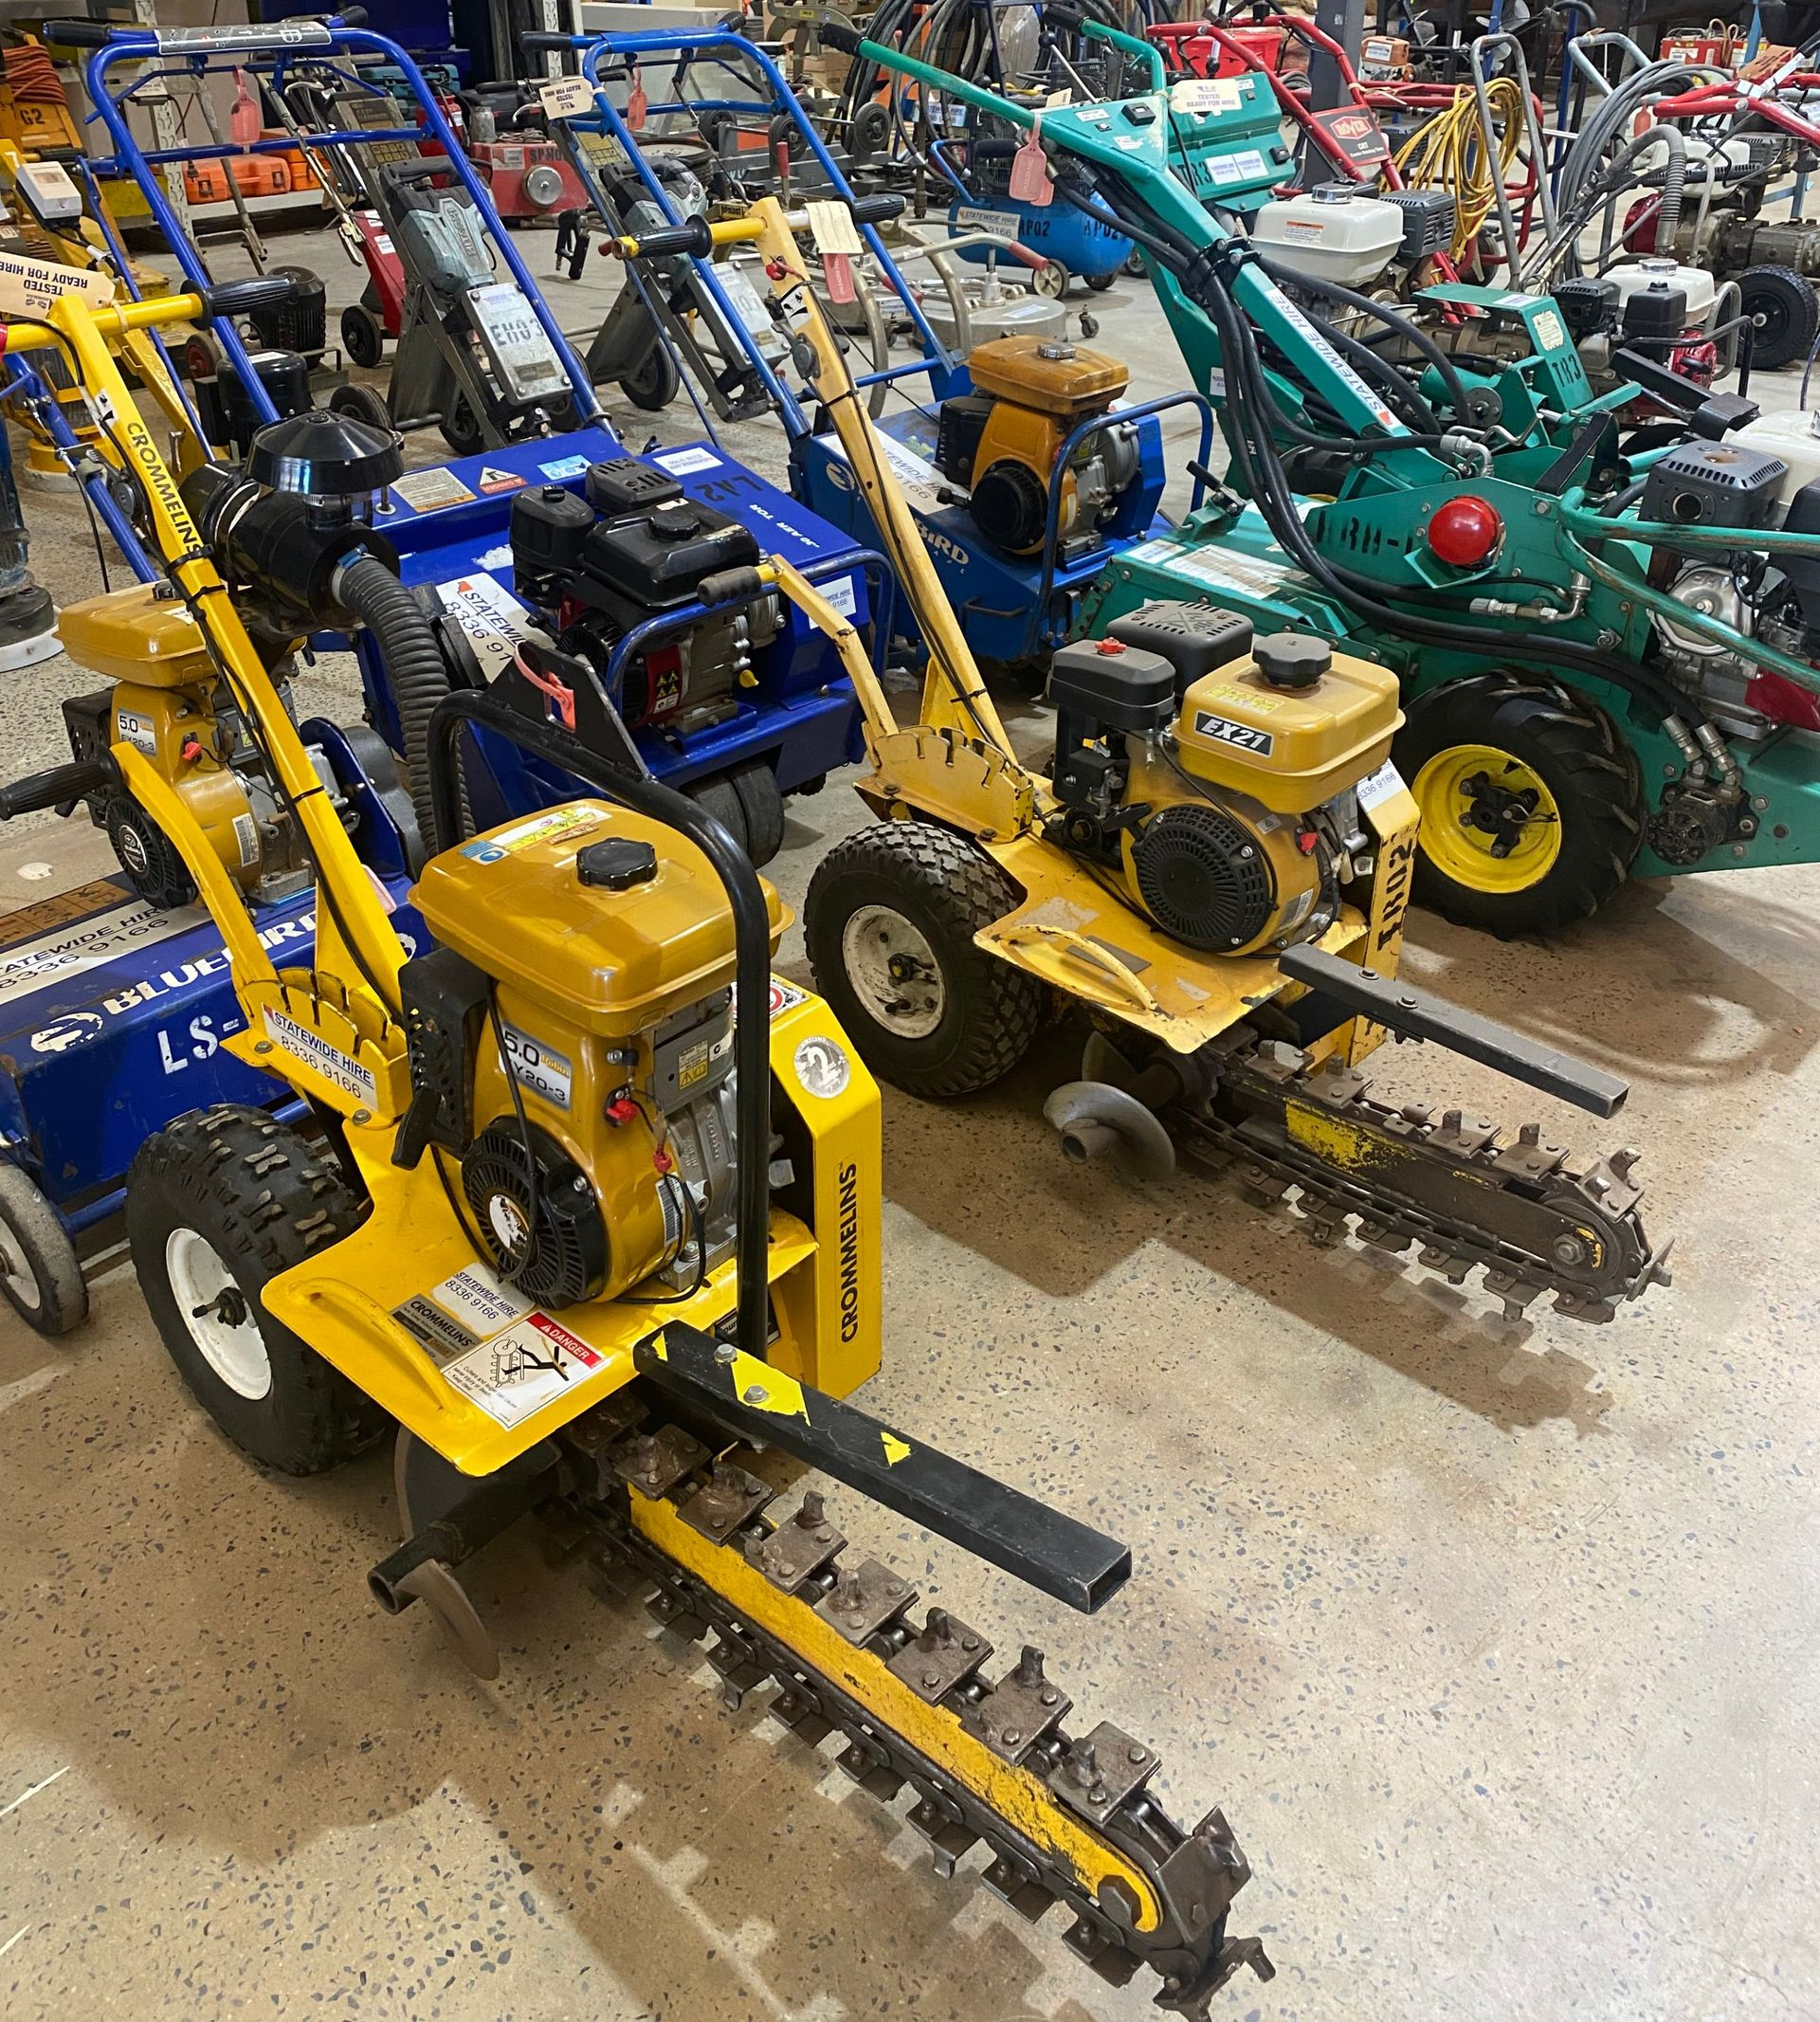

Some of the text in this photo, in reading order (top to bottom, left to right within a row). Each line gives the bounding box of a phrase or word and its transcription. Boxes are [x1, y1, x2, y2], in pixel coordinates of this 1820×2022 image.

[19, 108, 46, 126] G2
[963, 209, 1018, 226] STATEWIDE HIRE
[23, 279, 64, 296] TESTED
[27, 267, 49, 282] FOR
[50, 272, 89, 289] READY
[1271, 294, 1308, 329] HIRE
[1304, 332, 1383, 411] STATEWIDE
[885, 451, 930, 484] TEWIDE
[126, 422, 203, 553] CROMMELINS
[444, 601, 490, 640] 8336
[119, 715, 138, 734] 5.0
[1199, 718, 1266, 755] EX21
[1375, 772, 1397, 790] 9166
[0, 907, 163, 974] ATEWIDE HIR
[88, 918, 169, 953] 9166
[103, 909, 317, 1015] BLUEIR
[274, 1011, 372, 1084] STATEWIDE HIRE
[504, 1029, 540, 1067] 5.0
[282, 1035, 362, 1099] 8336 9166
[513, 1061, 566, 1102] Y20-3
[839, 1163, 859, 1343] CROMMELINS
[445, 1280, 500, 1320] 8336 9166
[455, 1271, 520, 1319] STATEWIDE HIRE
[410, 1300, 474, 1347] CROMMELINS
[548, 1329, 591, 1360] DANGER
